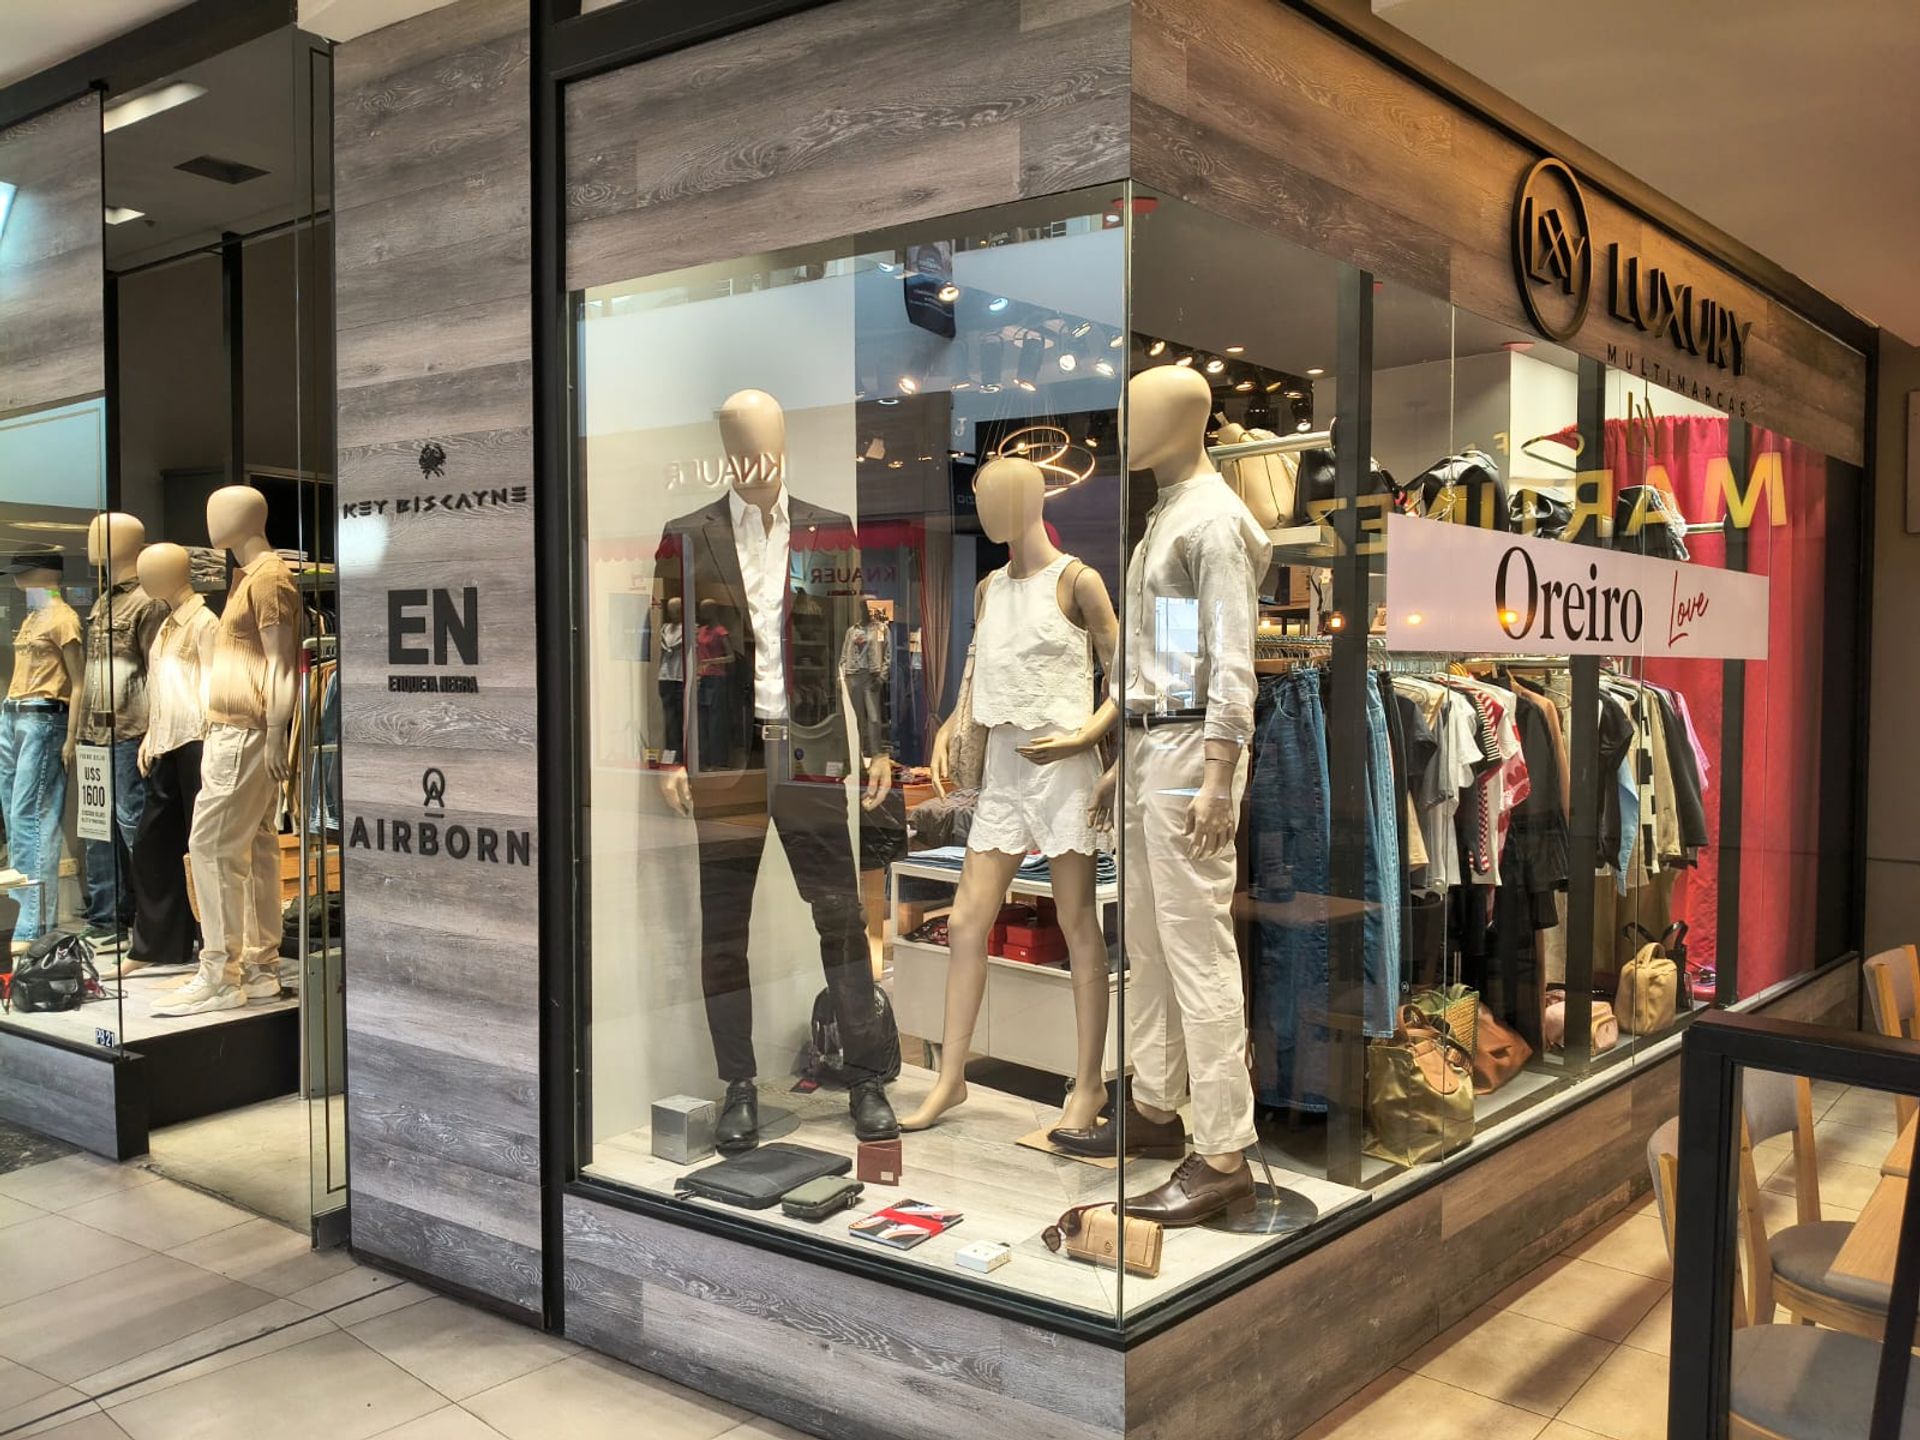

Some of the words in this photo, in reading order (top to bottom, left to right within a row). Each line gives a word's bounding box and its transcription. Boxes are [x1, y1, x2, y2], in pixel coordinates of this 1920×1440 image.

[1608, 241, 1753, 377] LUXURY
[1607, 343, 1747, 418] MULTIMARCAS
[343, 500, 389, 519] KEY
[396, 486, 527, 514] BISCAYNE
[388, 587, 479, 665] EN
[1495, 546, 1643, 643] Oreiro
[1668, 569, 1709, 648] Love
[82, 785, 106, 807] 1600
[350, 816, 530, 866] AIRBORN
